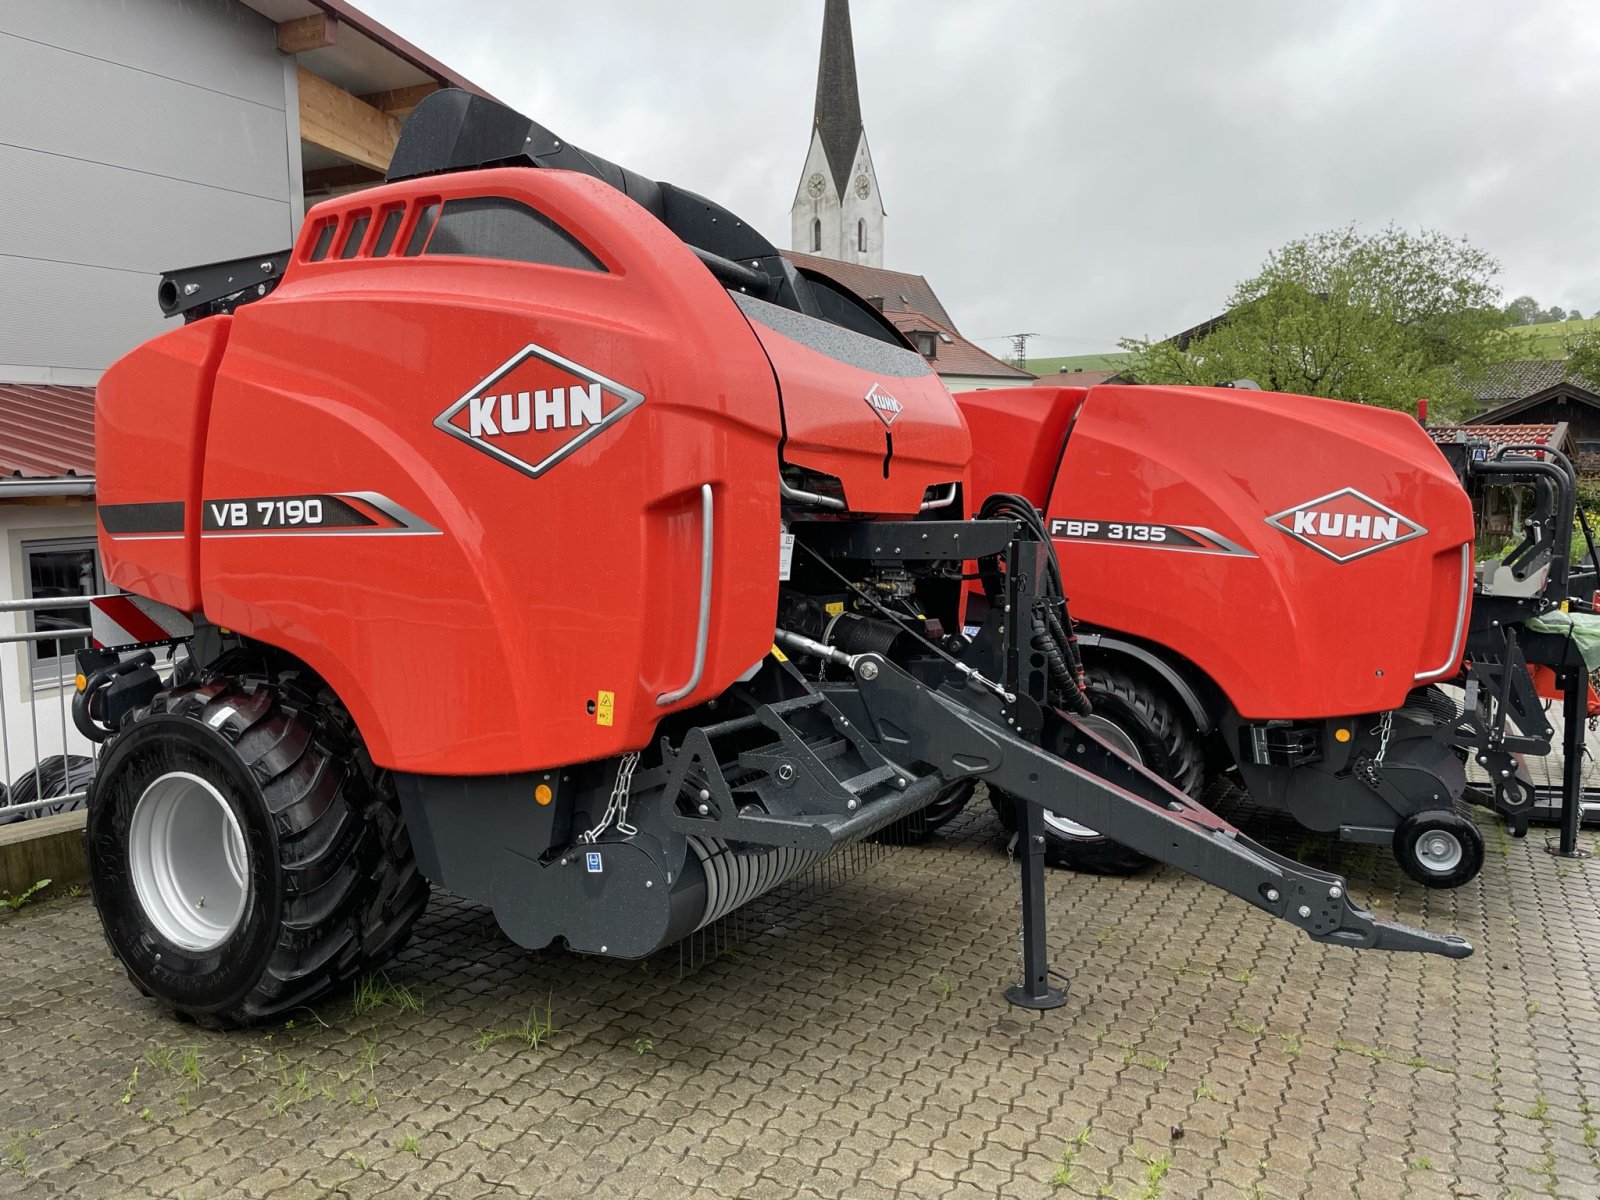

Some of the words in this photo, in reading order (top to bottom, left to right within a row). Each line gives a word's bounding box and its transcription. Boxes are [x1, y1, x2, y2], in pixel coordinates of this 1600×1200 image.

[469, 383, 602, 437] KUHN
[211, 503, 248, 526] VB
[257, 499, 323, 525] 7190
[1293, 511, 1398, 540] KUHN
[1051, 520, 1100, 536] FBP
[1107, 524, 1167, 541] 3135
